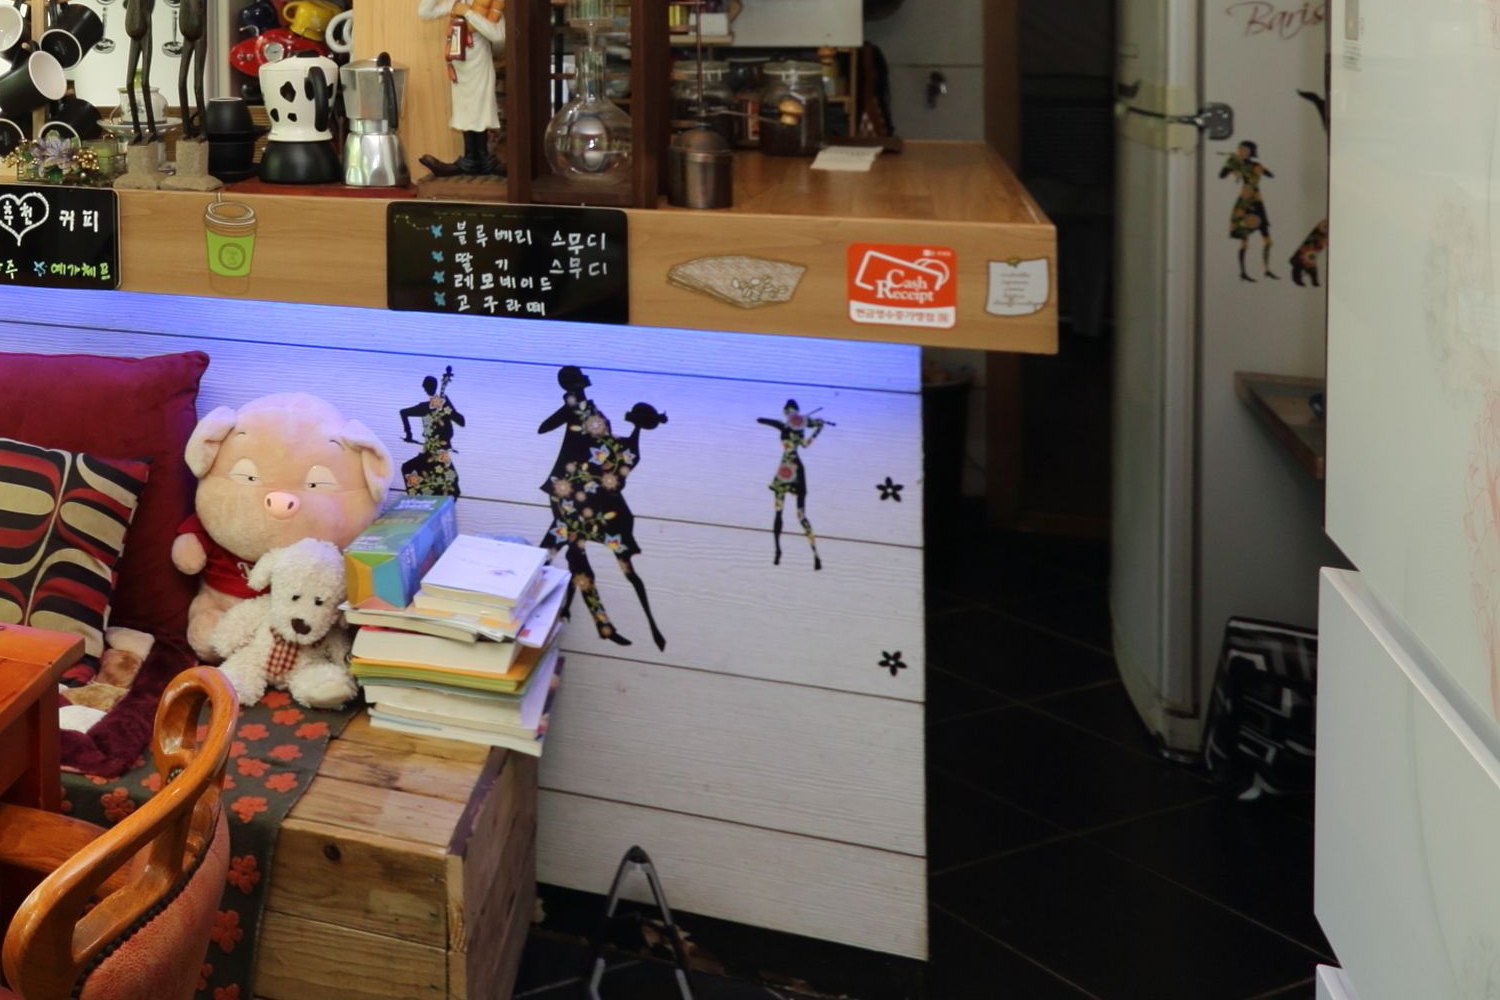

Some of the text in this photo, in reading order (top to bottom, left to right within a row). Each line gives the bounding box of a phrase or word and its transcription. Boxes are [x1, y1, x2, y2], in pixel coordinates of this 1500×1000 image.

[3, 200, 33, 227] 추천
[58, 209, 99, 233] 커피
[453, 220, 606, 255] 블루베리 스무디
[50, 262, 111, 281] 예가체프
[549, 256, 608, 279] 스무디
[886, 268, 928, 290] Cash
[453, 272, 552, 292] 레모네이드
[876, 279, 934, 304] Receipt
[457, 294, 546, 317] 고구라떼
